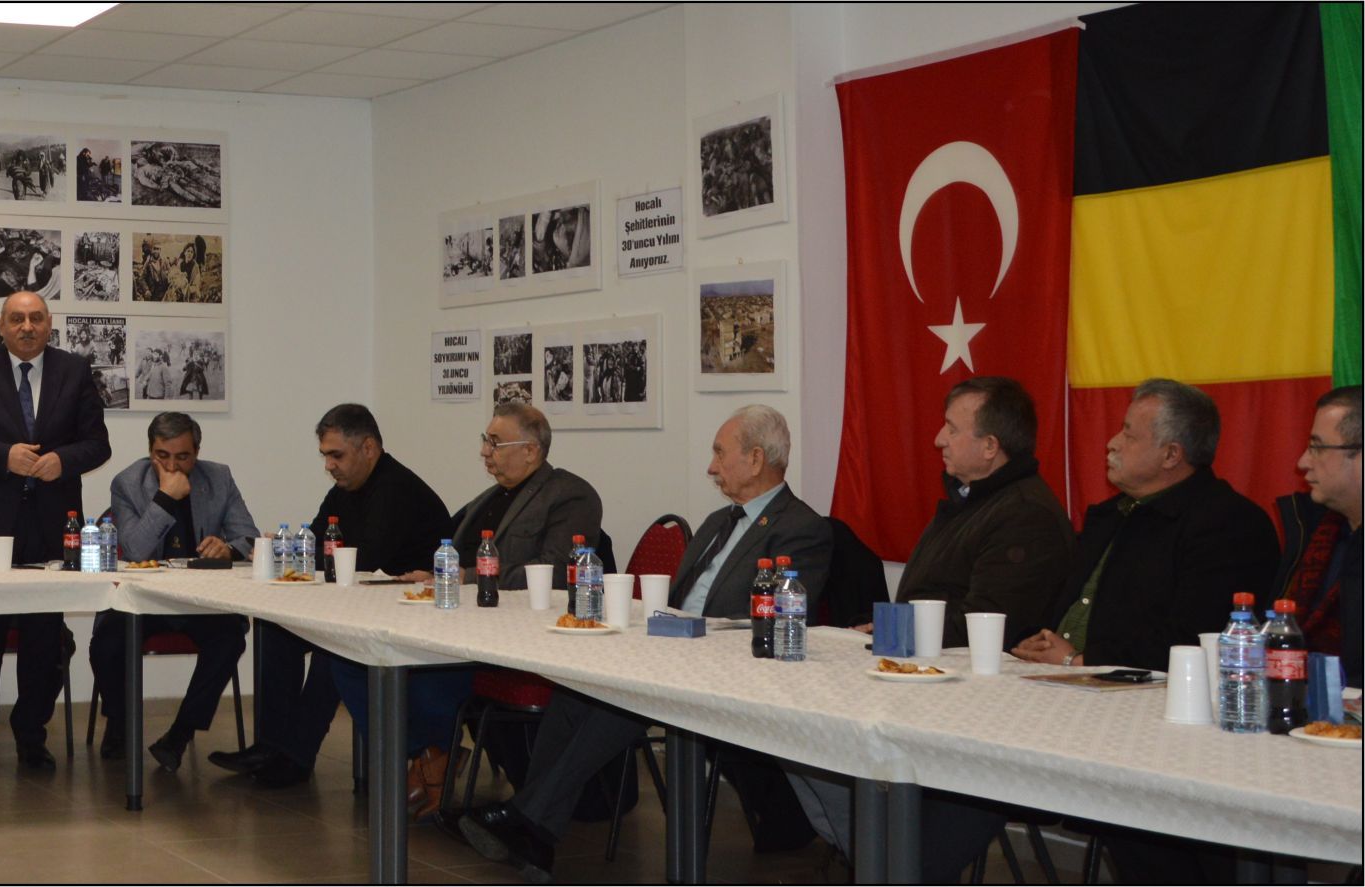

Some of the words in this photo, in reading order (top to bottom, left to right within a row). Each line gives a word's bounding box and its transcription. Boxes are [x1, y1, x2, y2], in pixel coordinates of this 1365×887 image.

[635, 197, 662, 212] Hocalı
[625, 214, 676, 236] Şehitlerinin
[656, 233, 680, 246] Yılını
[629, 255, 670, 270] Anıyoruz.
